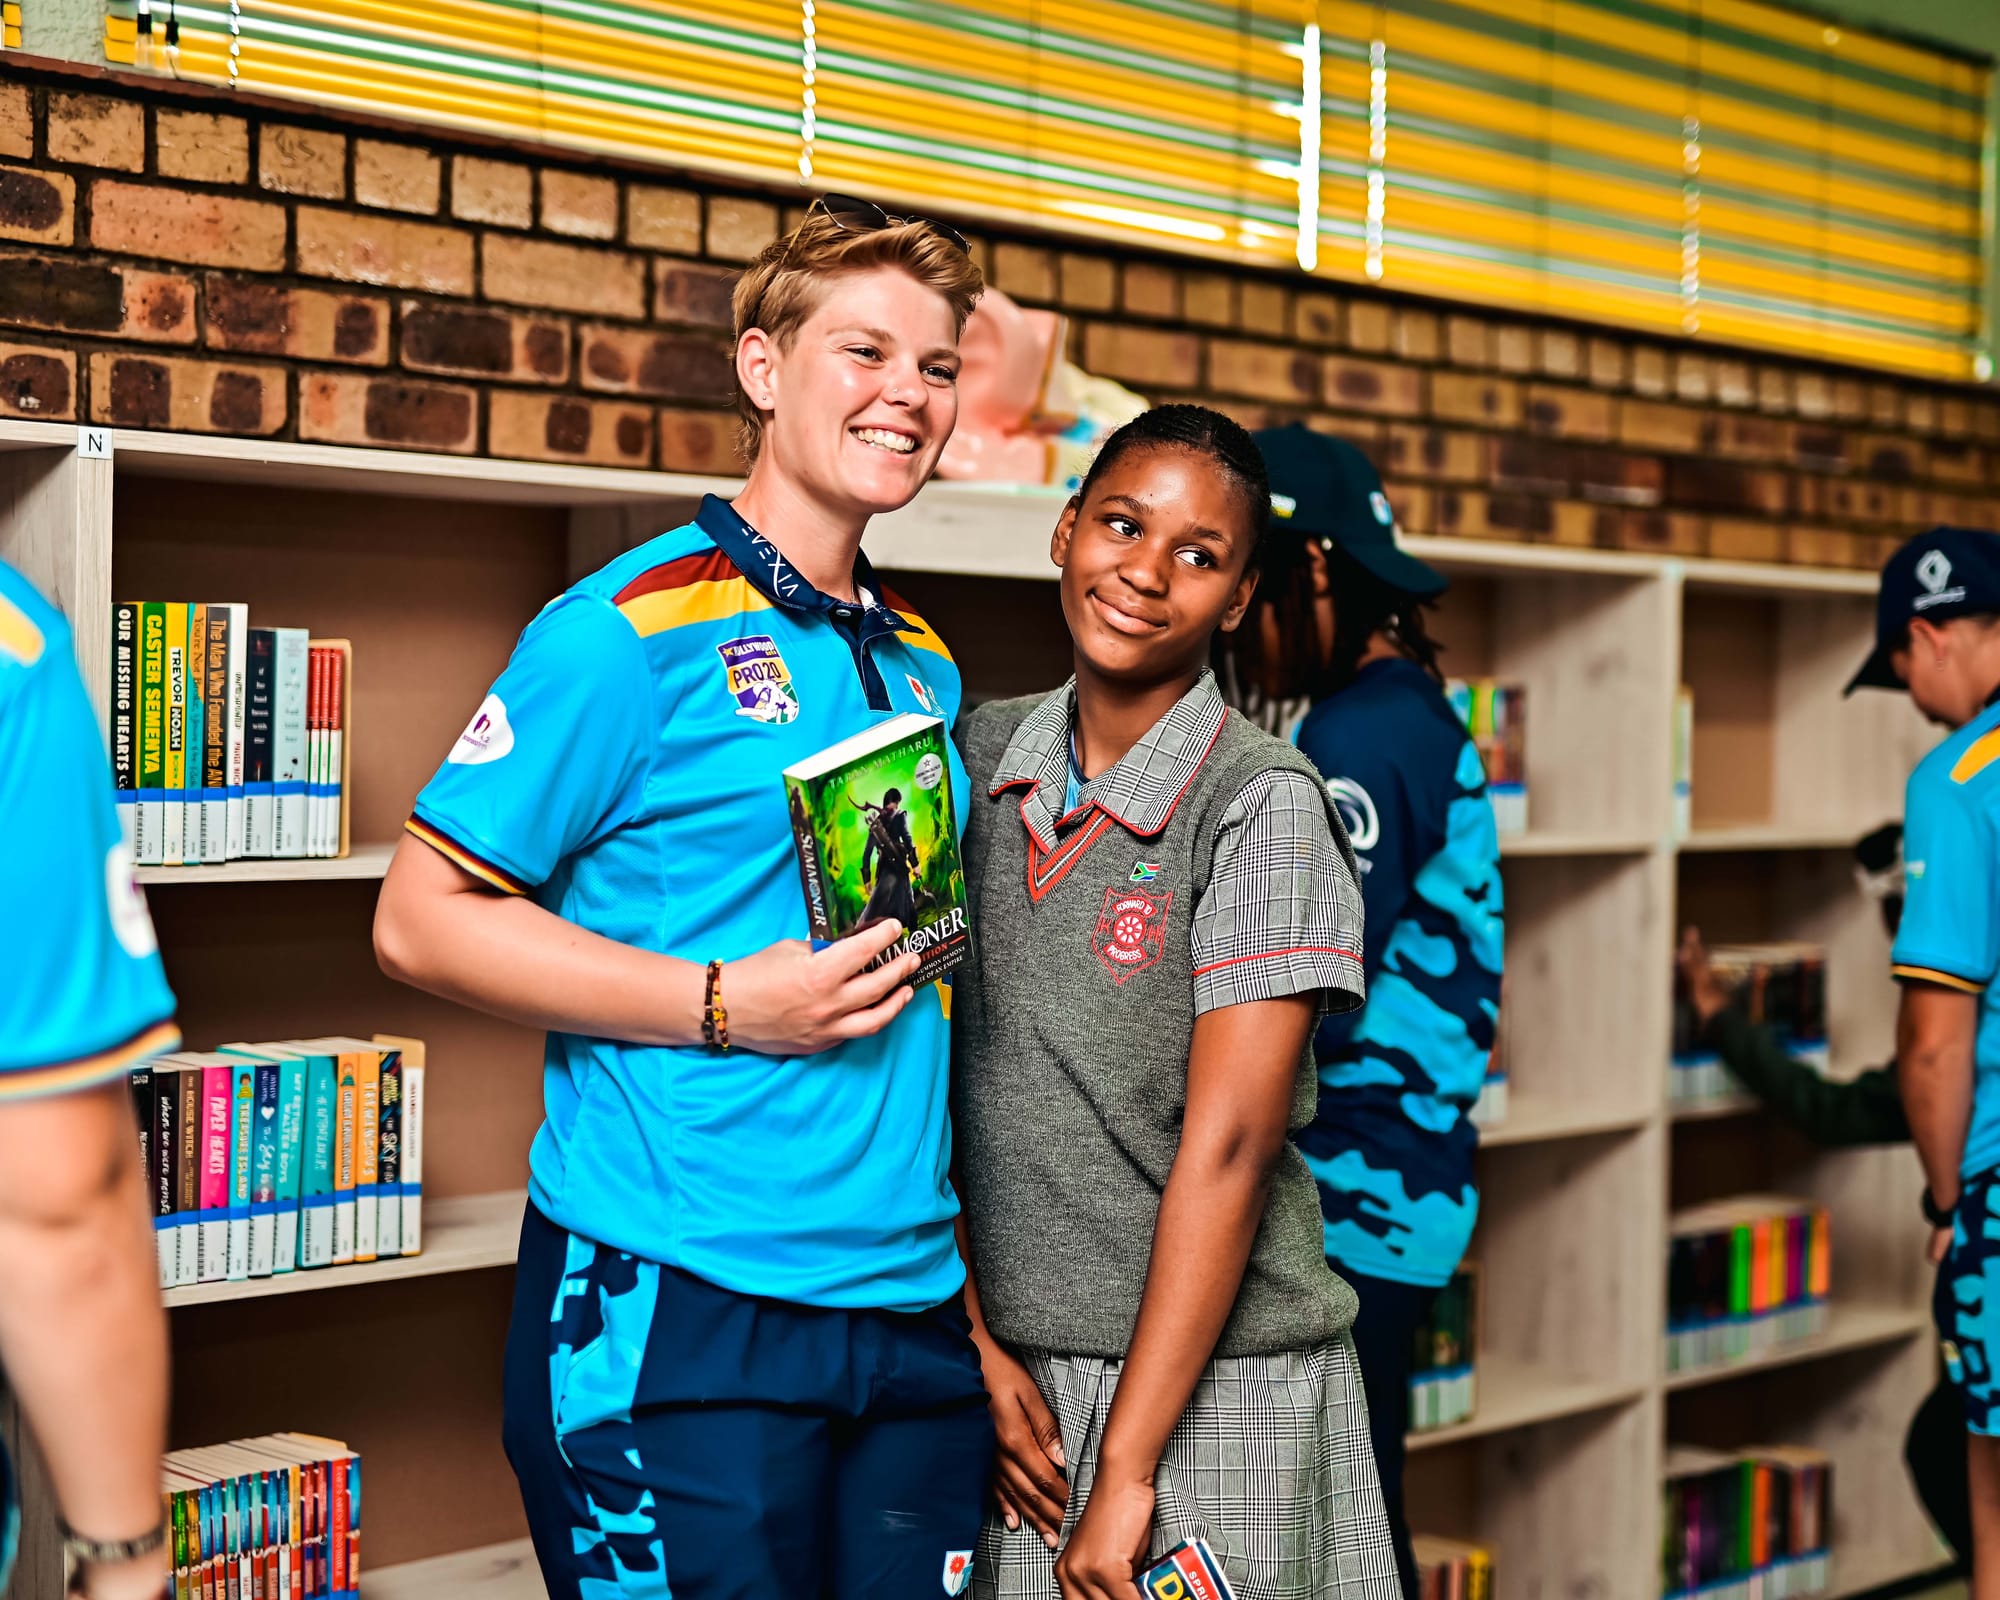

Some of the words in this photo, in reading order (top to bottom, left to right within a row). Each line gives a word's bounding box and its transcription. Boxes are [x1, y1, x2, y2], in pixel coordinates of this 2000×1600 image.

[88, 433, 103, 452] N
[118, 608, 133, 641] OUR
[210, 620, 227, 640] The
[146, 614, 163, 687] CASTER
[193, 652, 203, 673] Not
[210, 643, 227, 669] Man
[117, 646, 132, 711] MISSING
[171, 649, 183, 704] TREVOR
[209, 671, 226, 697] Who
[733, 661, 782, 689] PRO20
[144, 690, 162, 774] SEMENYA
[170, 709, 182, 749] NOAH
[208, 699, 226, 744] Founded
[116, 716, 131, 771] HEARTS
[208, 747, 225, 766] the
[208, 768, 223, 788] AN
[829, 766, 870, 789] TARAN
[873, 736, 931, 769] MATHARU
[800, 833, 828, 926] SUMMONER
[1116, 899, 1145, 913] FORWARD
[862, 907, 967, 973] MMONER
[1106, 944, 1142, 961] PROGRESS
[294, 1073, 302, 1092] MY
[186, 1090, 195, 1124] HOUSE
[209, 1096, 226, 1133] PAPER
[290, 1095, 301, 1143] RETURN
[185, 1125, 195, 1159] WITCH
[237, 1102, 250, 1153] TREASURE
[281, 1103, 291, 1149] WALTER
[208, 1135, 225, 1175] HEARTS
[279, 1152, 289, 1183] BOYS
[237, 1156, 249, 1199] ISLAND
[1153, 1571, 1193, 1600] D
